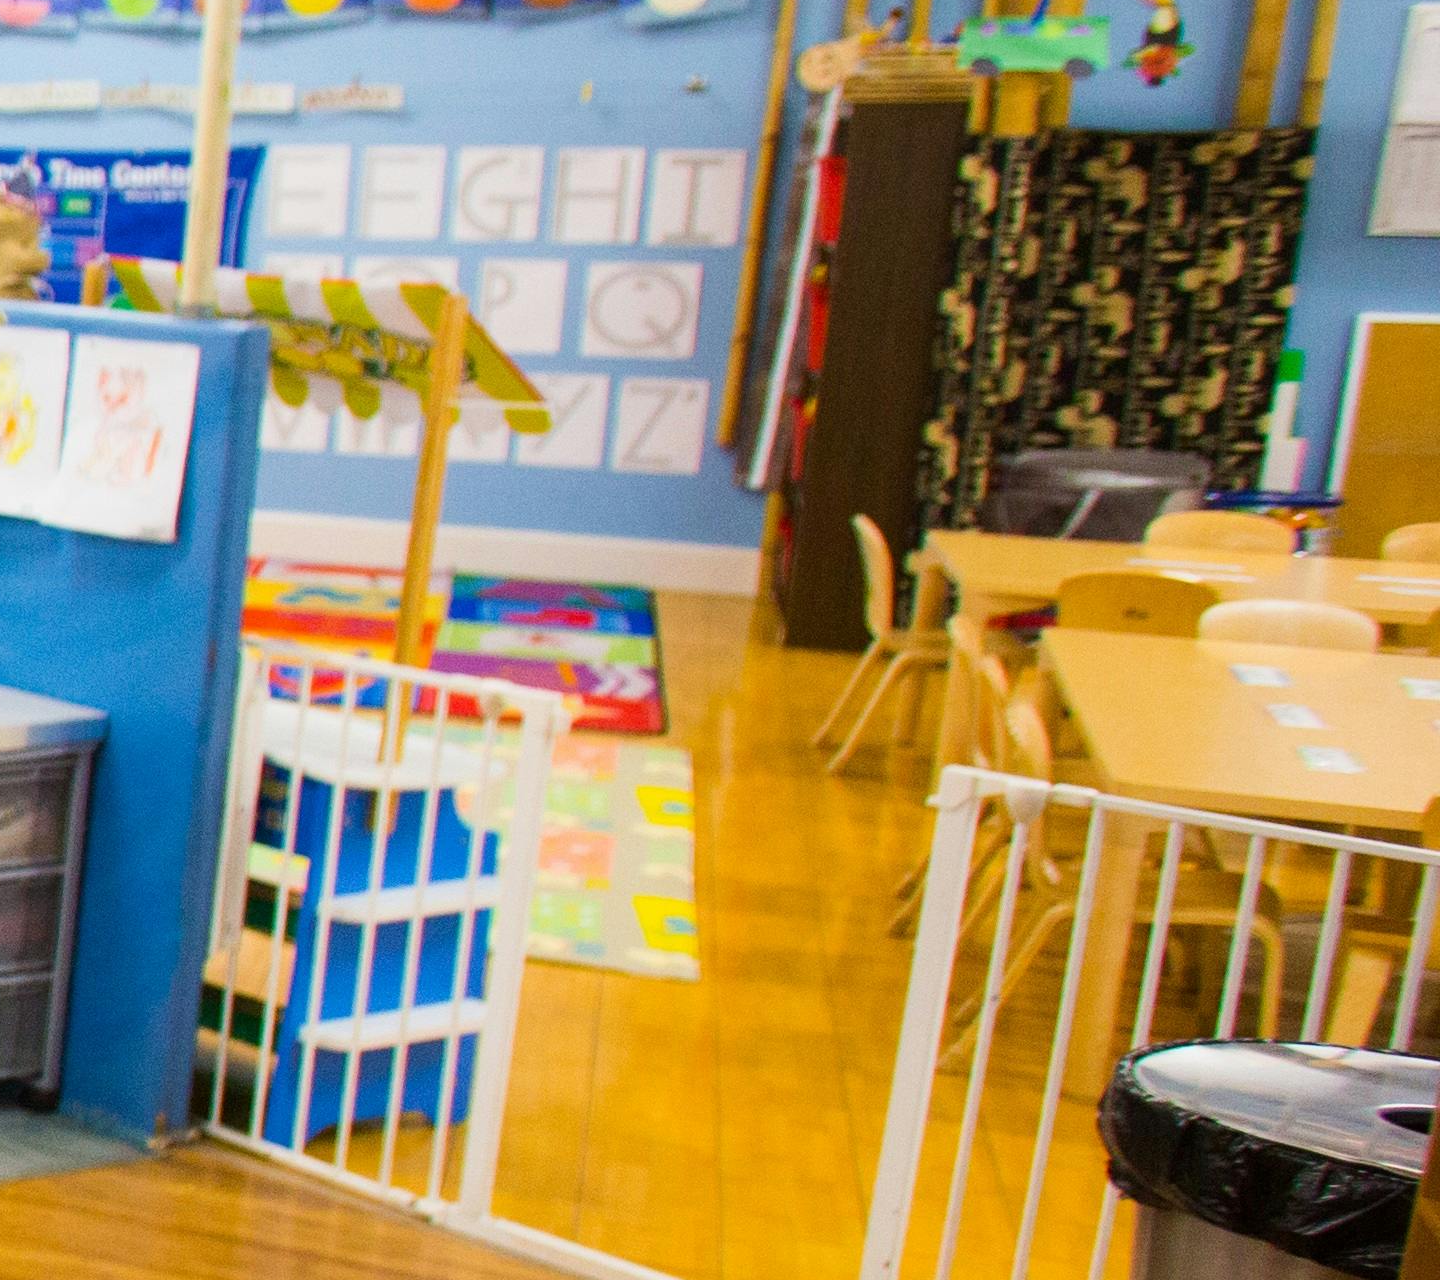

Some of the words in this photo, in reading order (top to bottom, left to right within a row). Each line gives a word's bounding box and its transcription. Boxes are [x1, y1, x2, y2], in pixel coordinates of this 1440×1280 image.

[47, 158, 107, 189] Time
[554, 154, 628, 241] H
[588, 267, 689, 349] Q
